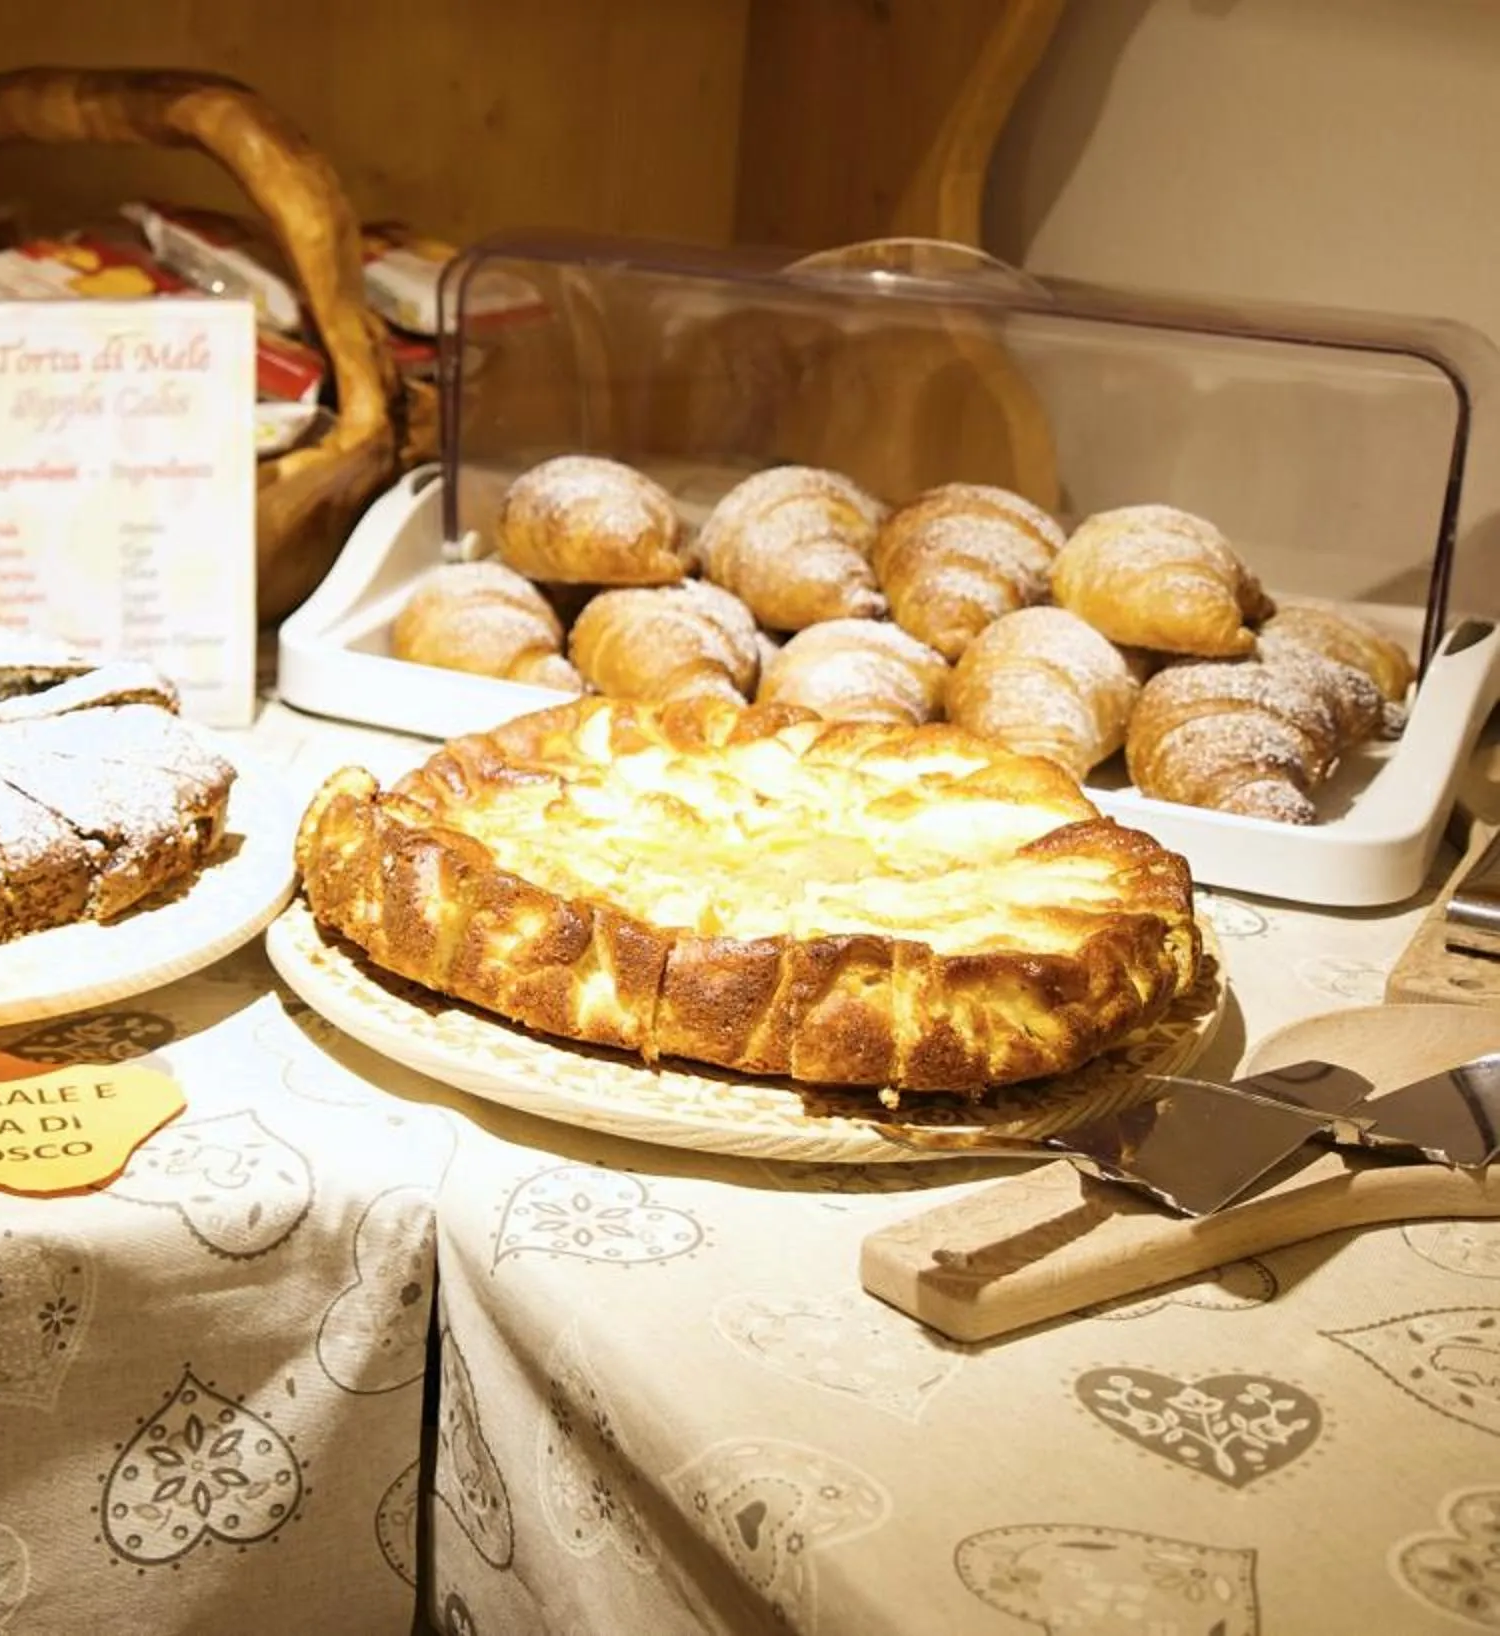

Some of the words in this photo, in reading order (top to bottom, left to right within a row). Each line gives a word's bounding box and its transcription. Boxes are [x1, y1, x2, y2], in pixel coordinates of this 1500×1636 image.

[134, 333, 211, 373] Mele
[94, 1082, 118, 1099] E
[40, 1114, 83, 1132] DI
